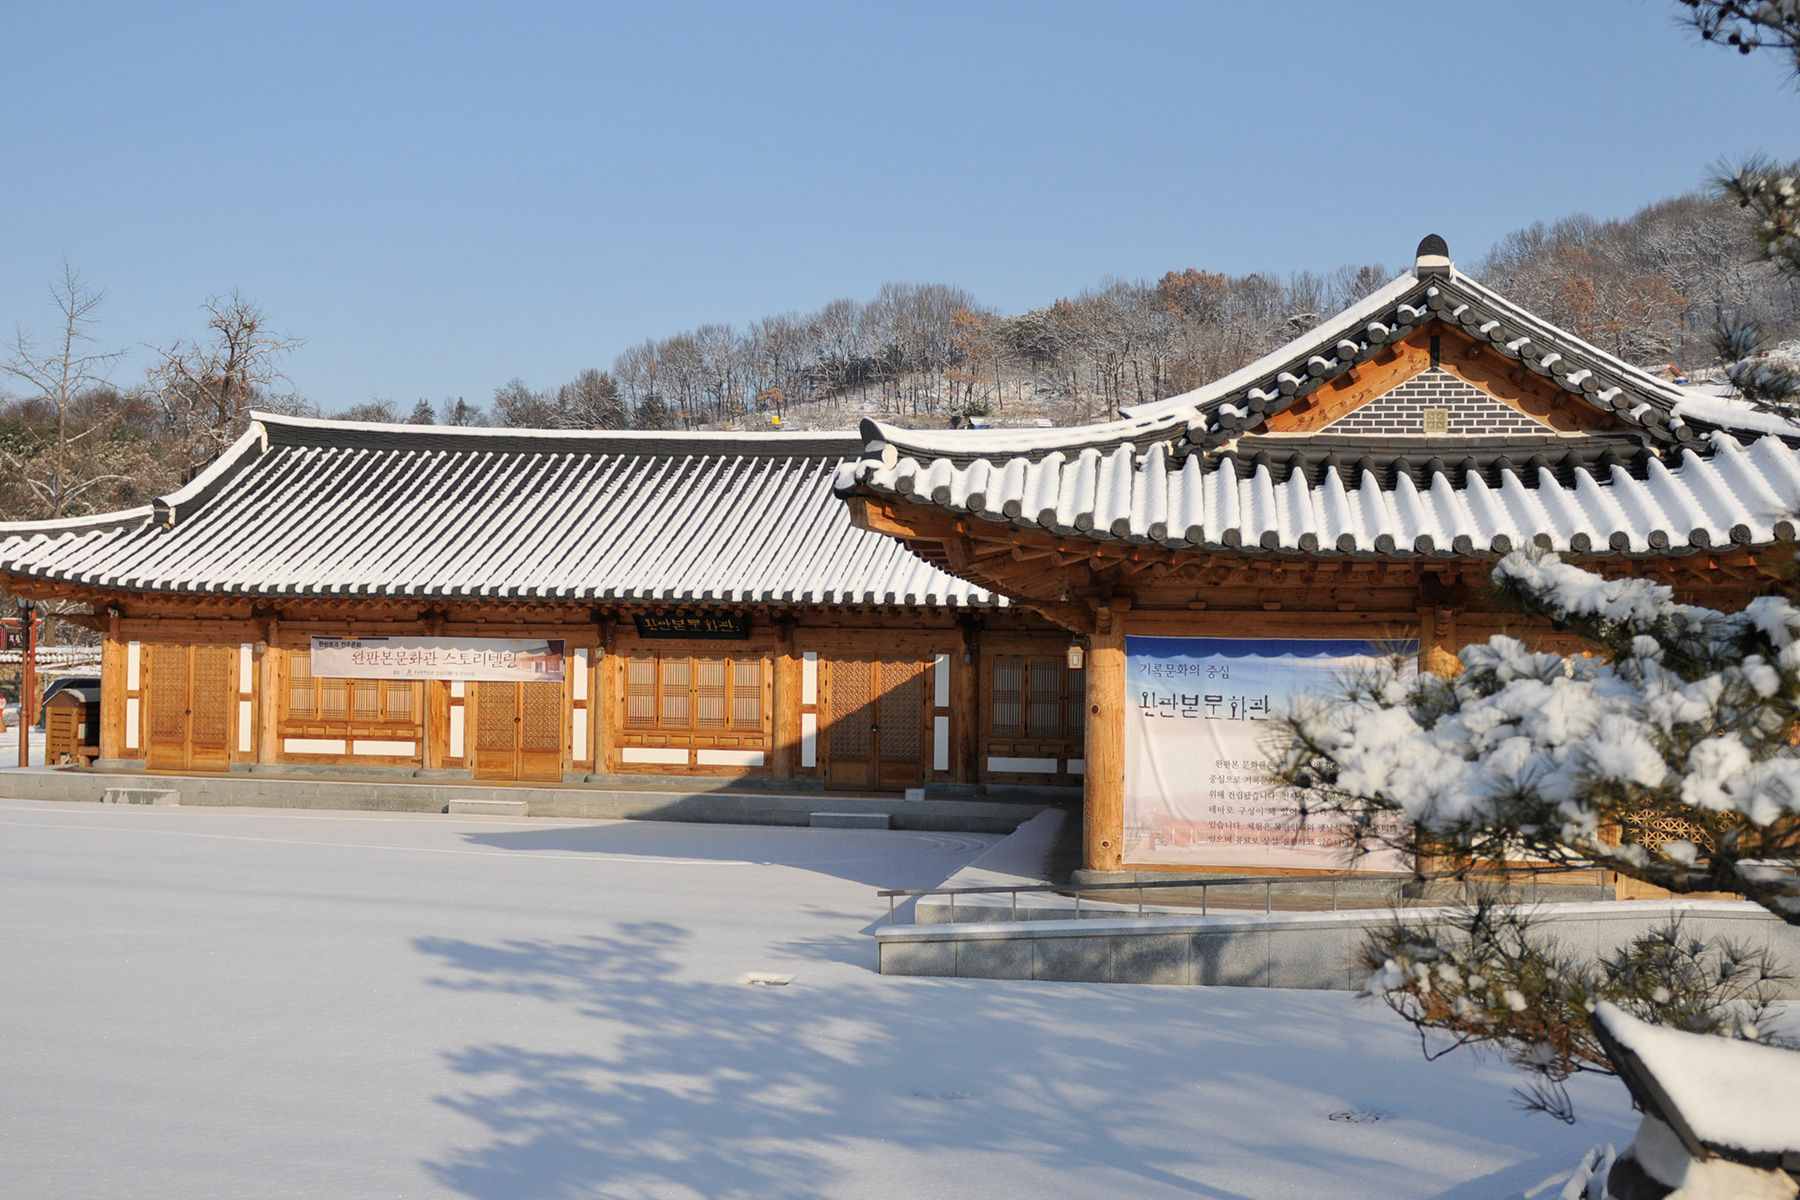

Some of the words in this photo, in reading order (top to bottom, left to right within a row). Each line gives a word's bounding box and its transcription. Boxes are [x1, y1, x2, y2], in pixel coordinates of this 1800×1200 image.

[351, 650, 437, 667] 완판본문화관
[442, 651, 518, 669] 스토리텔링
[1140, 663, 1200, 678] 기록문화의
[1205, 664, 1230, 680] 중심
[1138, 690, 1271, 722] 완판본문화관
[1215, 759, 1239, 769] 완판본
[1209, 774, 1241, 784] 중심으로
[1209, 789, 1225, 799] 위해
[1208, 805, 1235, 815] 테마로
[1238, 806, 1264, 816] 구성이
[1208, 820, 1243, 830] 있습니다.
[1246, 822, 1271, 831] 체험은
[1208, 835, 1233, 844] 있으며
[1235, 836, 1260, 845] 유료로
